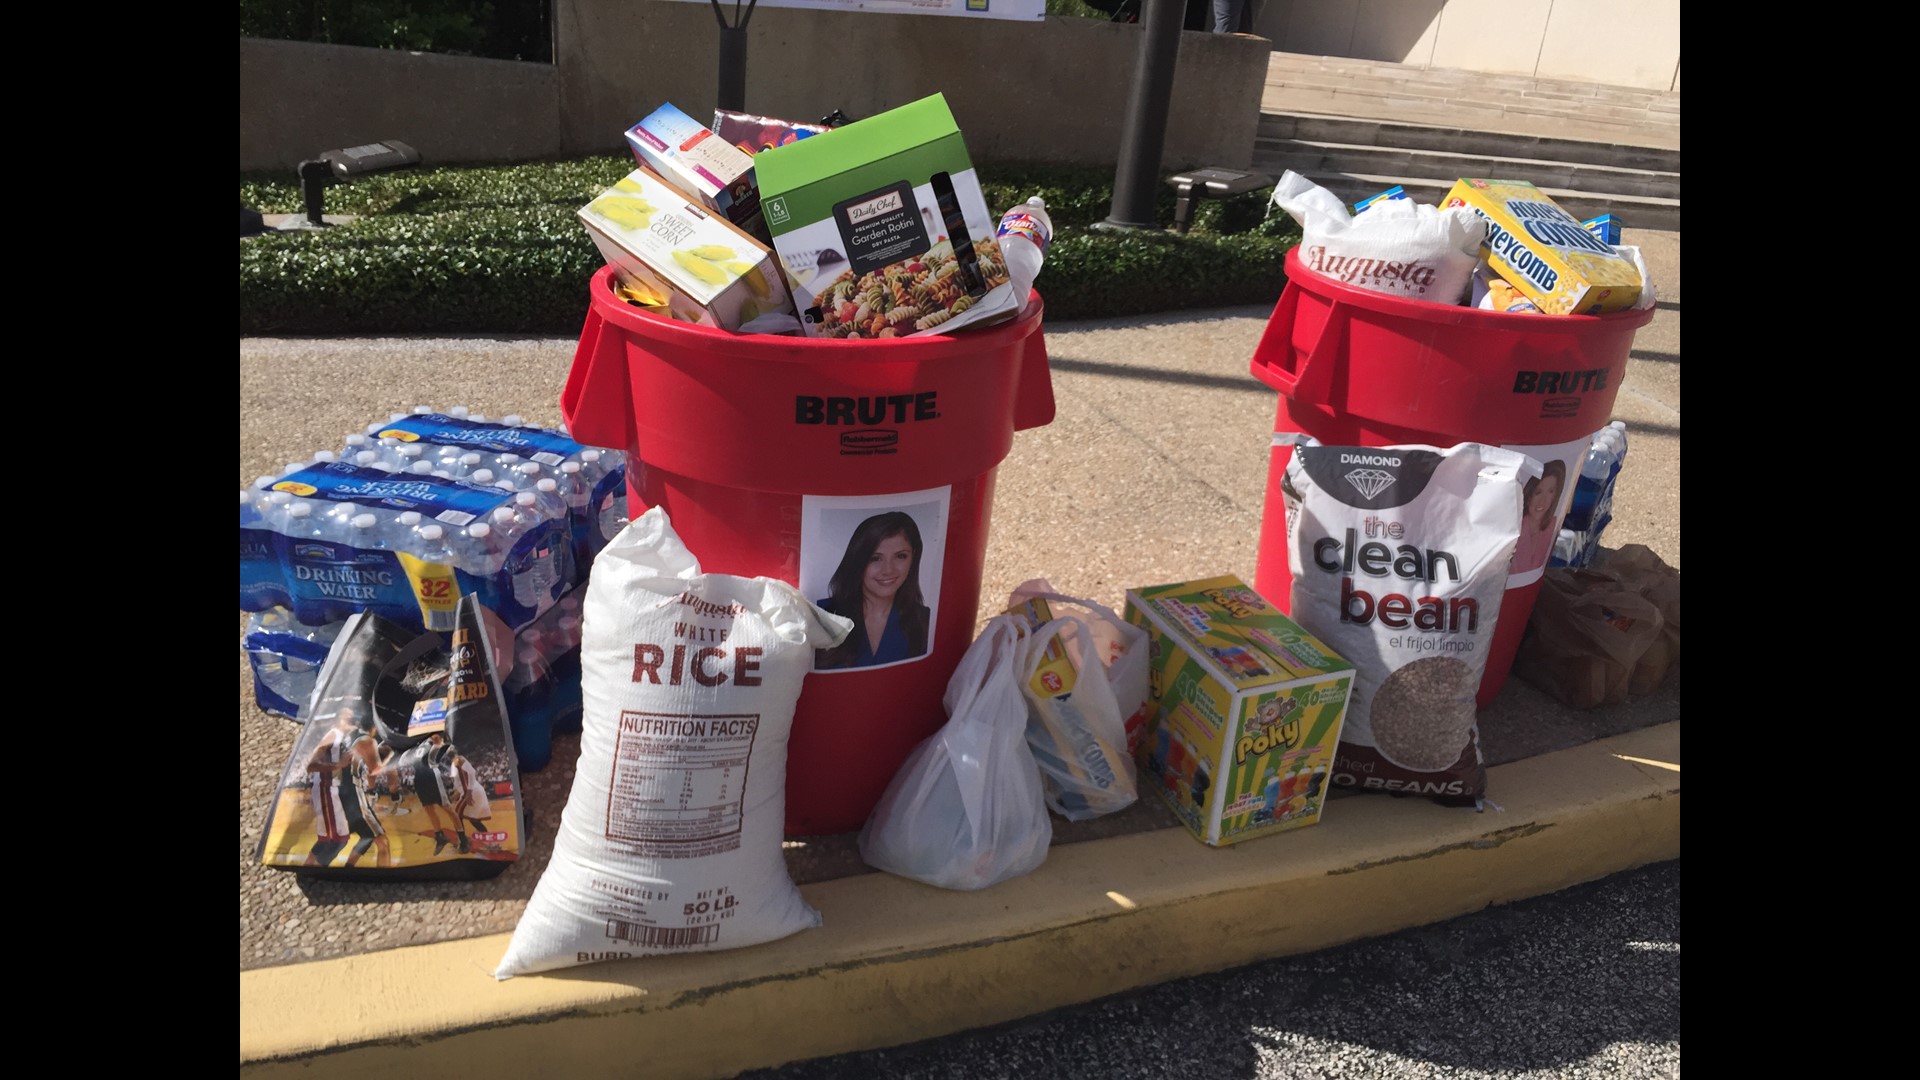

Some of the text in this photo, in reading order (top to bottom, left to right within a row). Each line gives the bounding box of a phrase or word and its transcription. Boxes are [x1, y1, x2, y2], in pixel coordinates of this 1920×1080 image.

[773, 202, 781, 211] 6
[852, 195, 897, 219] Daily Chef
[650, 222, 686, 247] CORN
[660, 213, 696, 239] SWEET
[851, 217, 915, 246] Garden Rotini
[1524, 219, 1617, 256] COMB
[1308, 245, 1436, 287] Augusta
[1360, 277, 1426, 294] BRAND
[1513, 367, 1610, 395] BRUTE
[1340, 453, 1402, 468] DIAMOND
[1363, 516, 1405, 540] the
[1313, 527, 1461, 583] clean
[295, 564, 393, 586] DRINKING
[315, 582, 378, 599] WATER
[420, 577, 451, 598] 32
[1201, 588, 1254, 620] Poky
[1340, 576, 1479, 634] bean
[674, 621, 728, 643] WHITE
[1389, 636, 1475, 655] el frijol limpio
[632, 643, 763, 688] RICE
[623, 717, 757, 737] NUTRITION FACTS
[1235, 718, 1301, 767] Poky
[1363, 776, 1465, 796] BEANS
[658, 892, 670, 901] BY
[683, 895, 740, 916] 50 LB.
